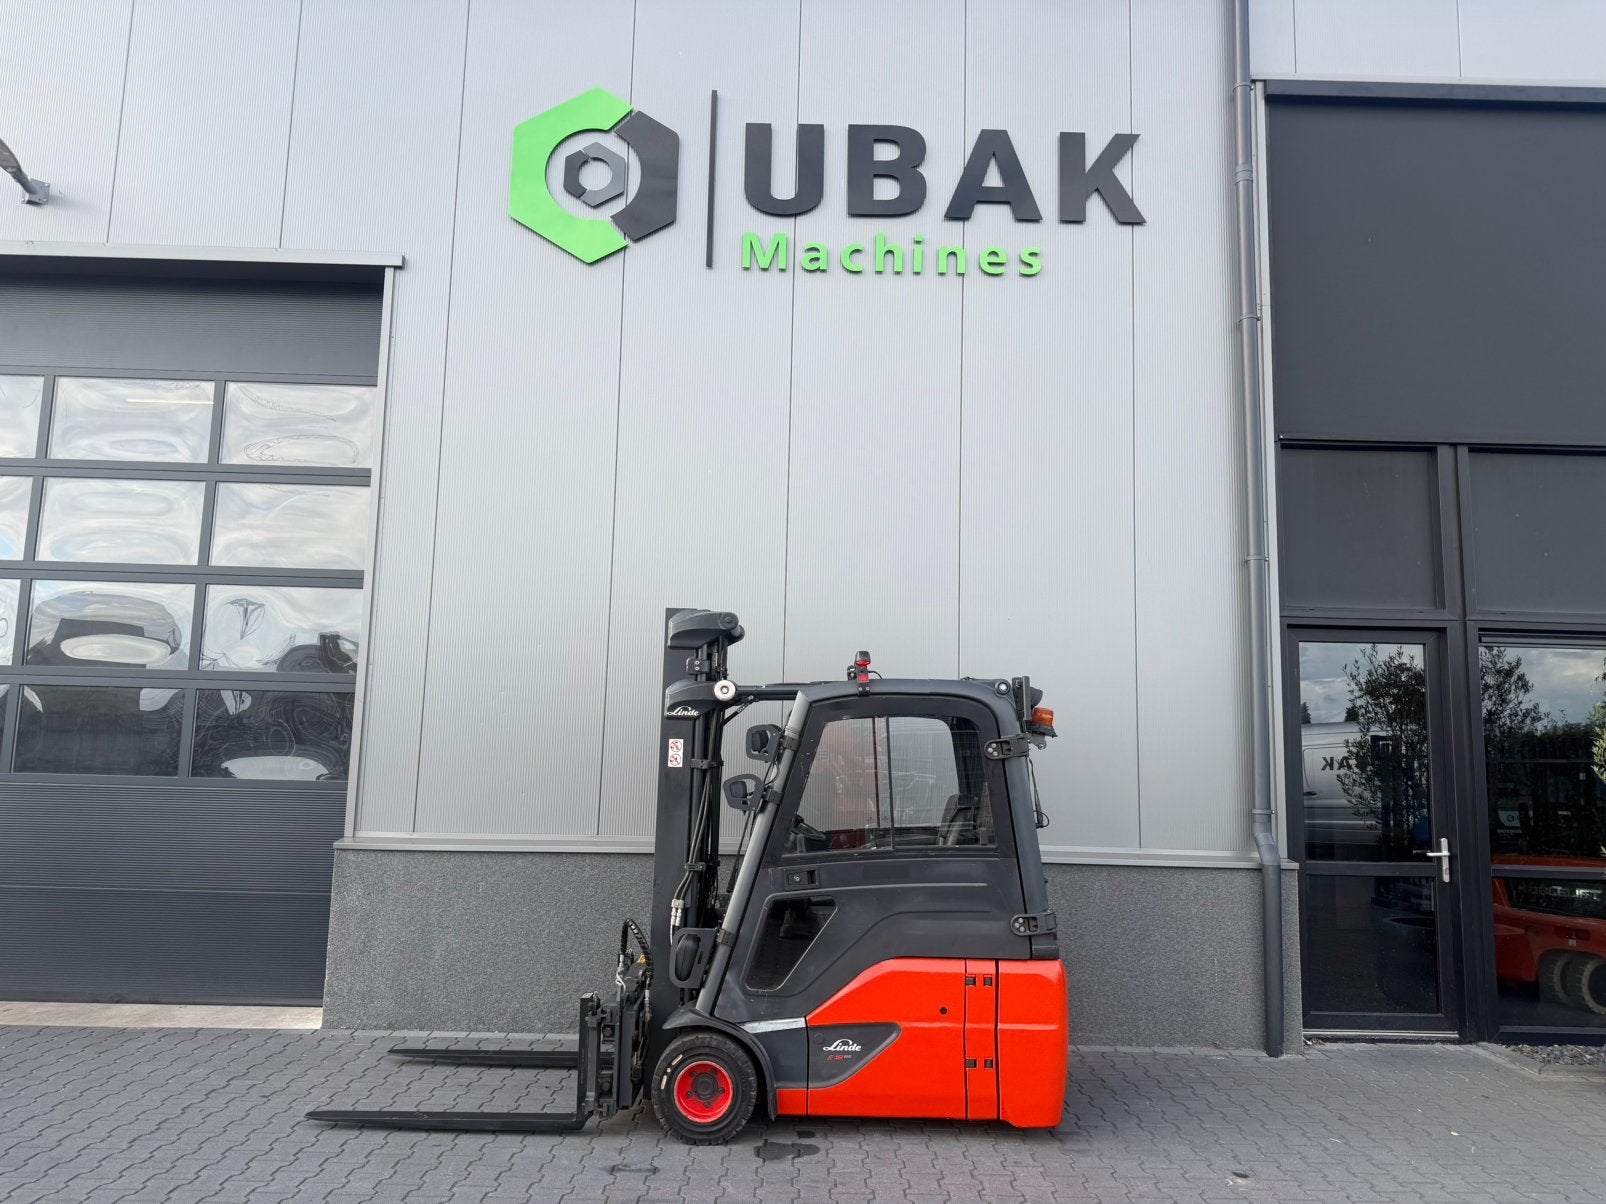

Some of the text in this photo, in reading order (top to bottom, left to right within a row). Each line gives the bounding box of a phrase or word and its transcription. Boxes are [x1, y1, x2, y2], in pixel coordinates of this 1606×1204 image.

[744, 122, 1147, 225] UBAK
[741, 231, 1043, 276] Machines
[666, 705, 699, 716] Linde
[823, 1038, 862, 1052] Linde
